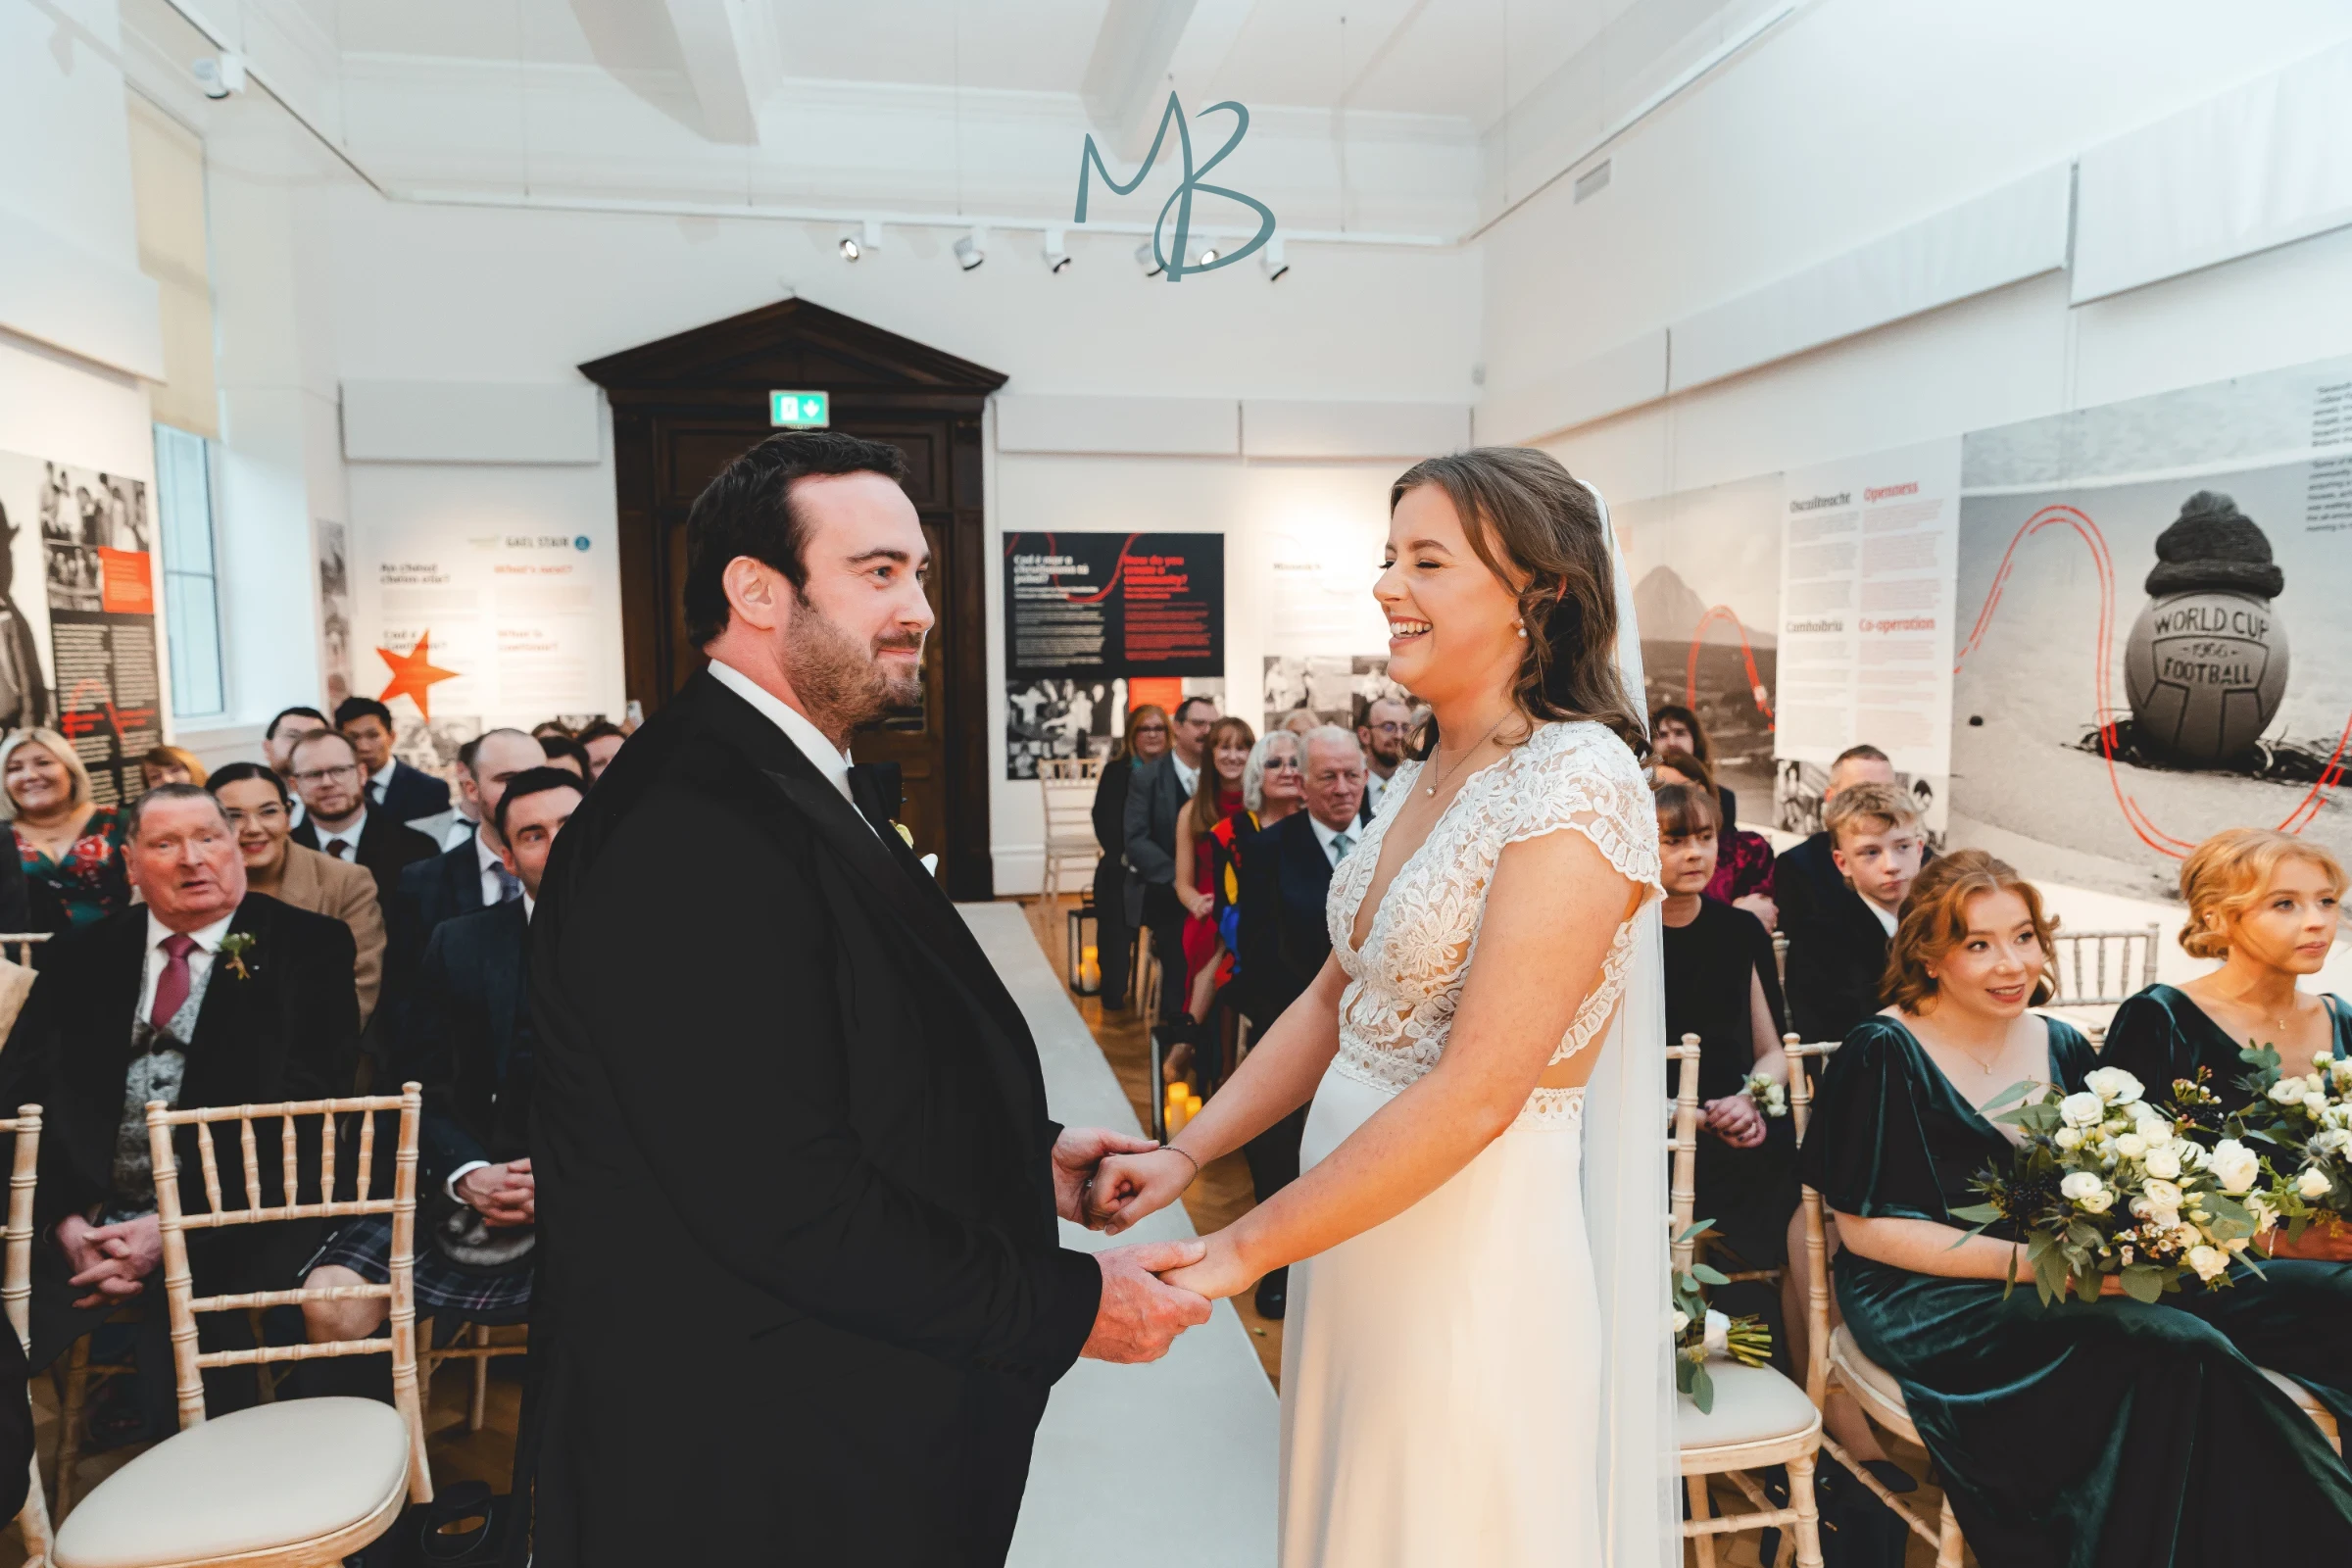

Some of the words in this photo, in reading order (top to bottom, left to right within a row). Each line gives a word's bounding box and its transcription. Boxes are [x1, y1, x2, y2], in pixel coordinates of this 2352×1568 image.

[1864, 481, 1919, 503] Openness
[1859, 617, 1936, 636] Co-operation
[2155, 608, 2228, 635] WORLD
[2232, 612, 2270, 641] CUP
[2162, 657, 2252, 684] FOOTBALL
